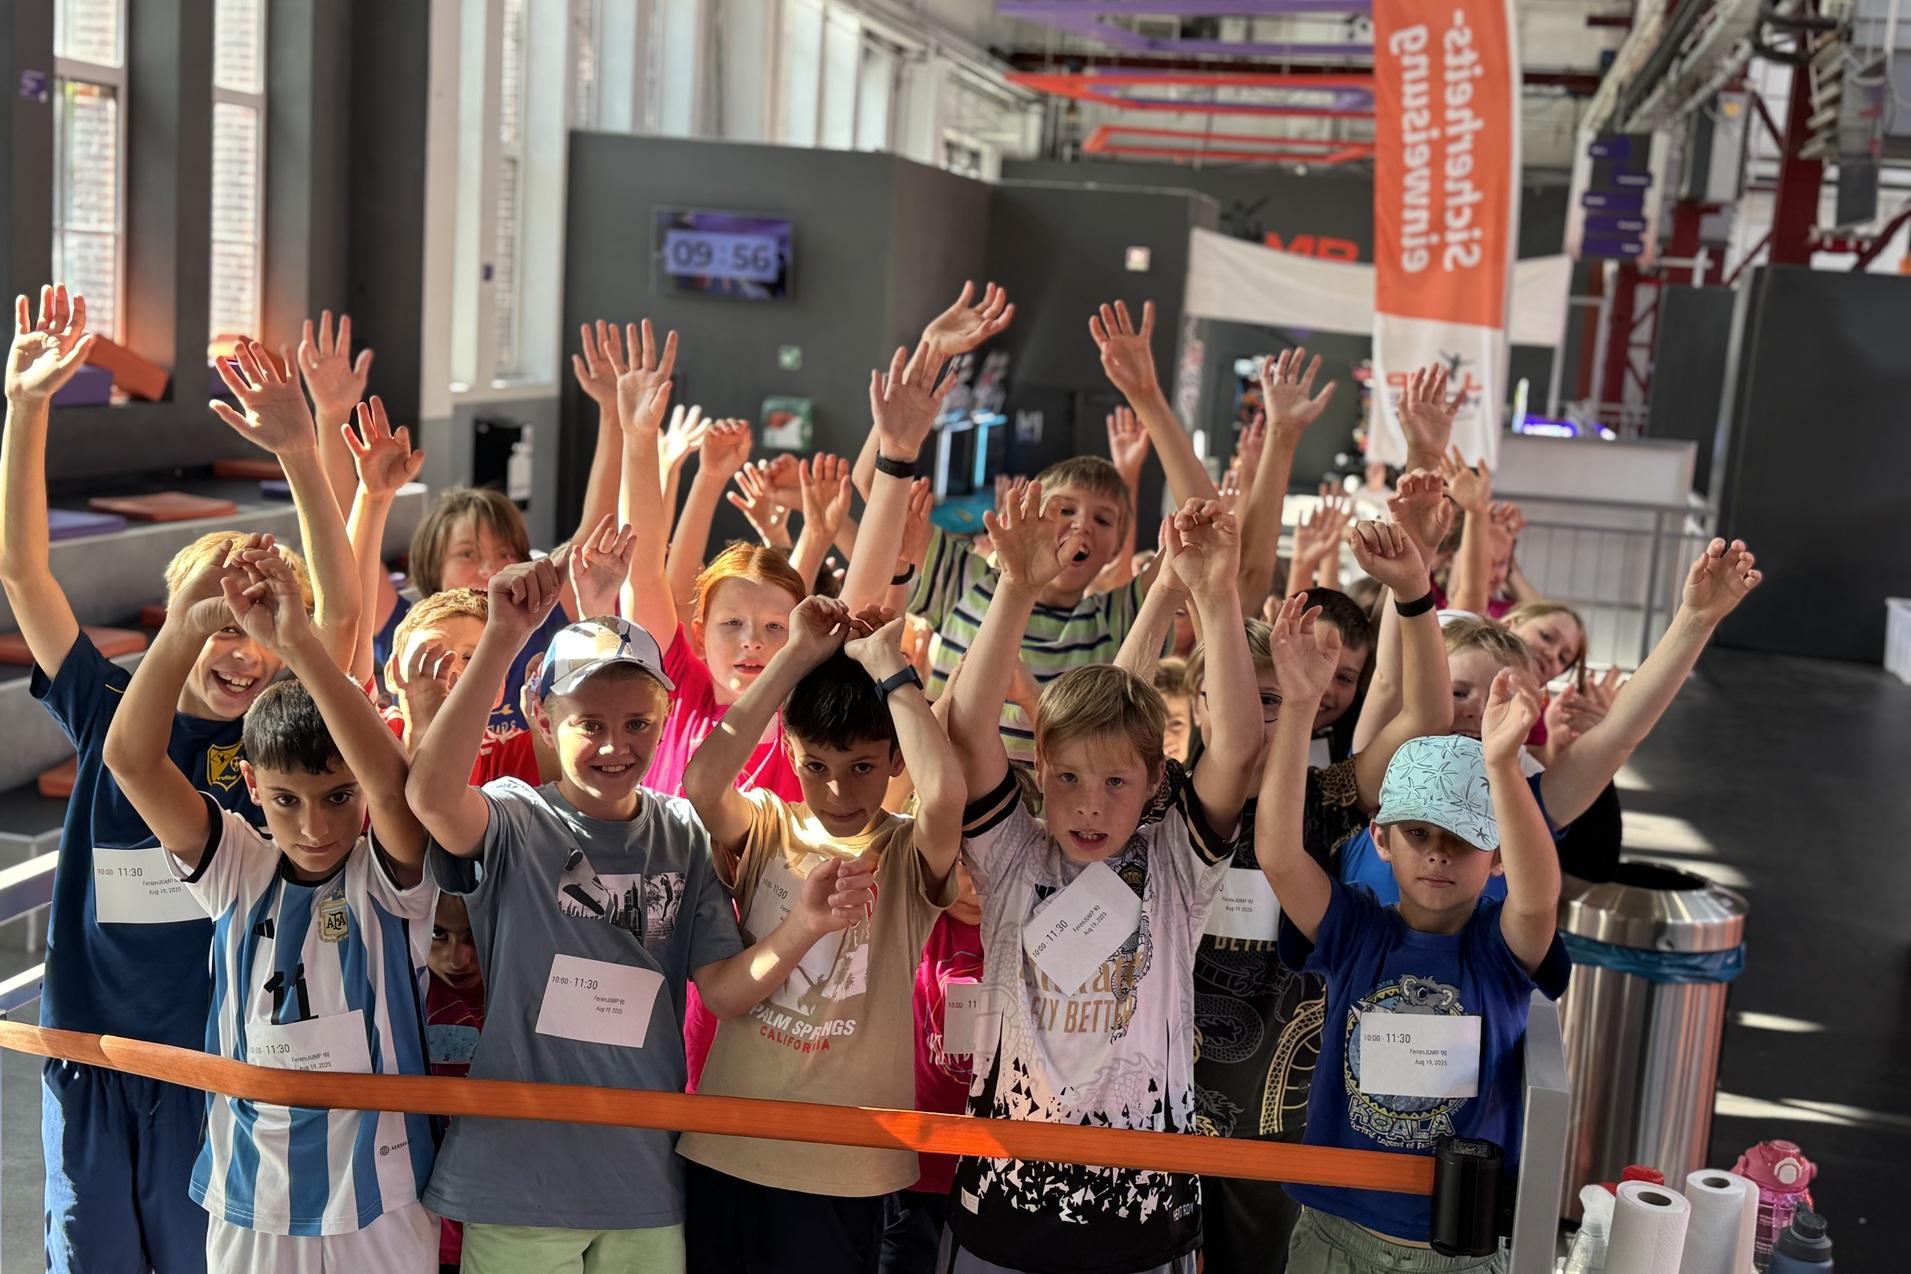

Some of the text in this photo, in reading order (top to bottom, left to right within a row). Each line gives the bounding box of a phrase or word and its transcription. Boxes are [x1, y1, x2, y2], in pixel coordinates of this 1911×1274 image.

[118, 867, 143, 877] 11:30
[326, 911, 346, 930] AFA
[1033, 942, 1047, 957] 10:00
[1046, 919, 1068, 941] 11:30
[552, 975, 569, 985] 10:00
[574, 977, 598, 991] 11:30
[264, 963, 319, 1026] 11
[748, 1004, 793, 1031] PALM
[1364, 1034, 1381, 1042] 10:00
[1386, 1033, 1411, 1043] 11:30
[266, 1043, 290, 1055] 11:30
[318, 1061, 332, 1069] 2025
[1348, 1095, 1456, 1142] KOALA
